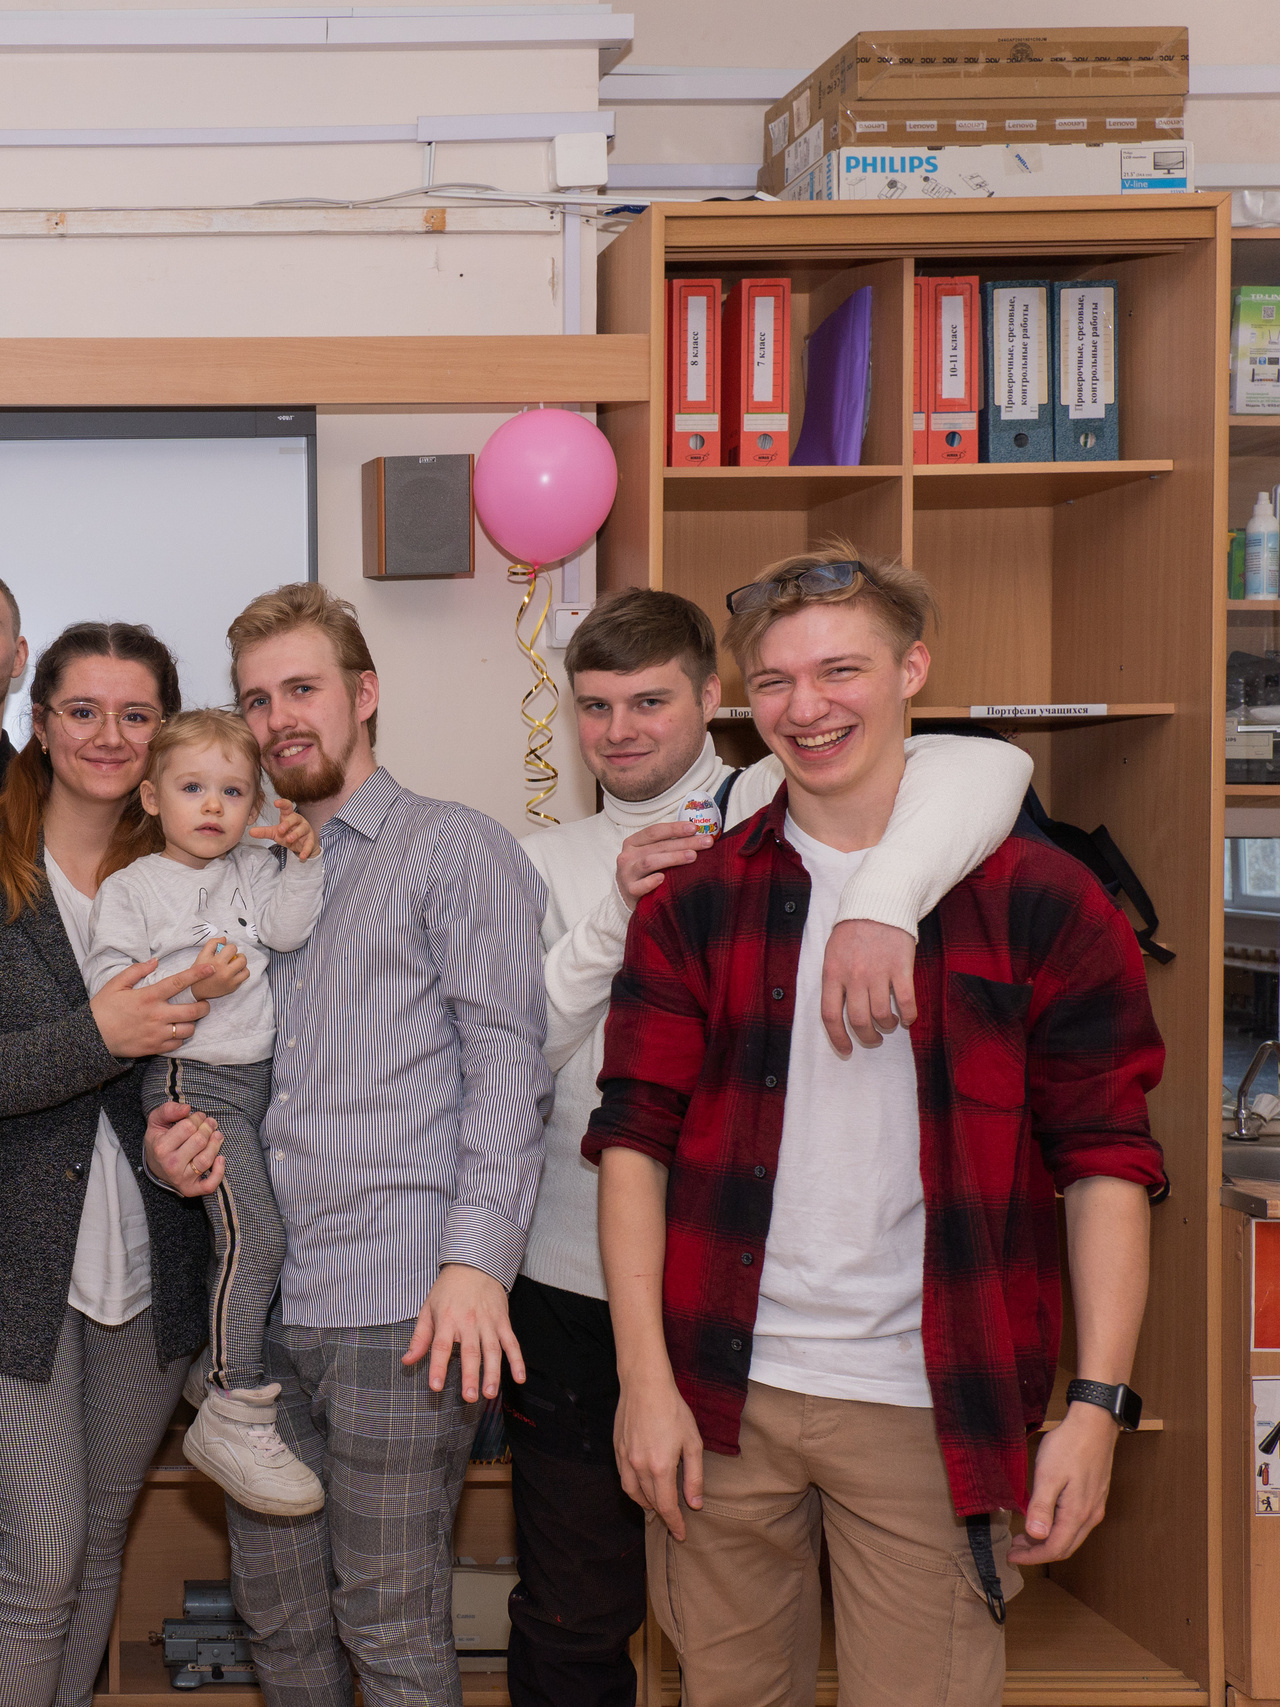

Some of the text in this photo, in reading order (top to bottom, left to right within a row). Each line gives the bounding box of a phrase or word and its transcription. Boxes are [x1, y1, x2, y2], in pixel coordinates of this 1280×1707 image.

[845, 156, 939, 174] PHILIPS
[1124, 180, 1149, 188] V-line
[949, 353, 958, 378] 10-11
[1005, 296, 1017, 413] Проверочные, срезовые,
[1020, 304, 1030, 406] контрольные работы
[1075, 294, 1086, 412] Проверочные, срезовые,
[1090, 302, 1100, 404] контрольные работы
[986, 706, 1089, 717] Портфели учащихся
